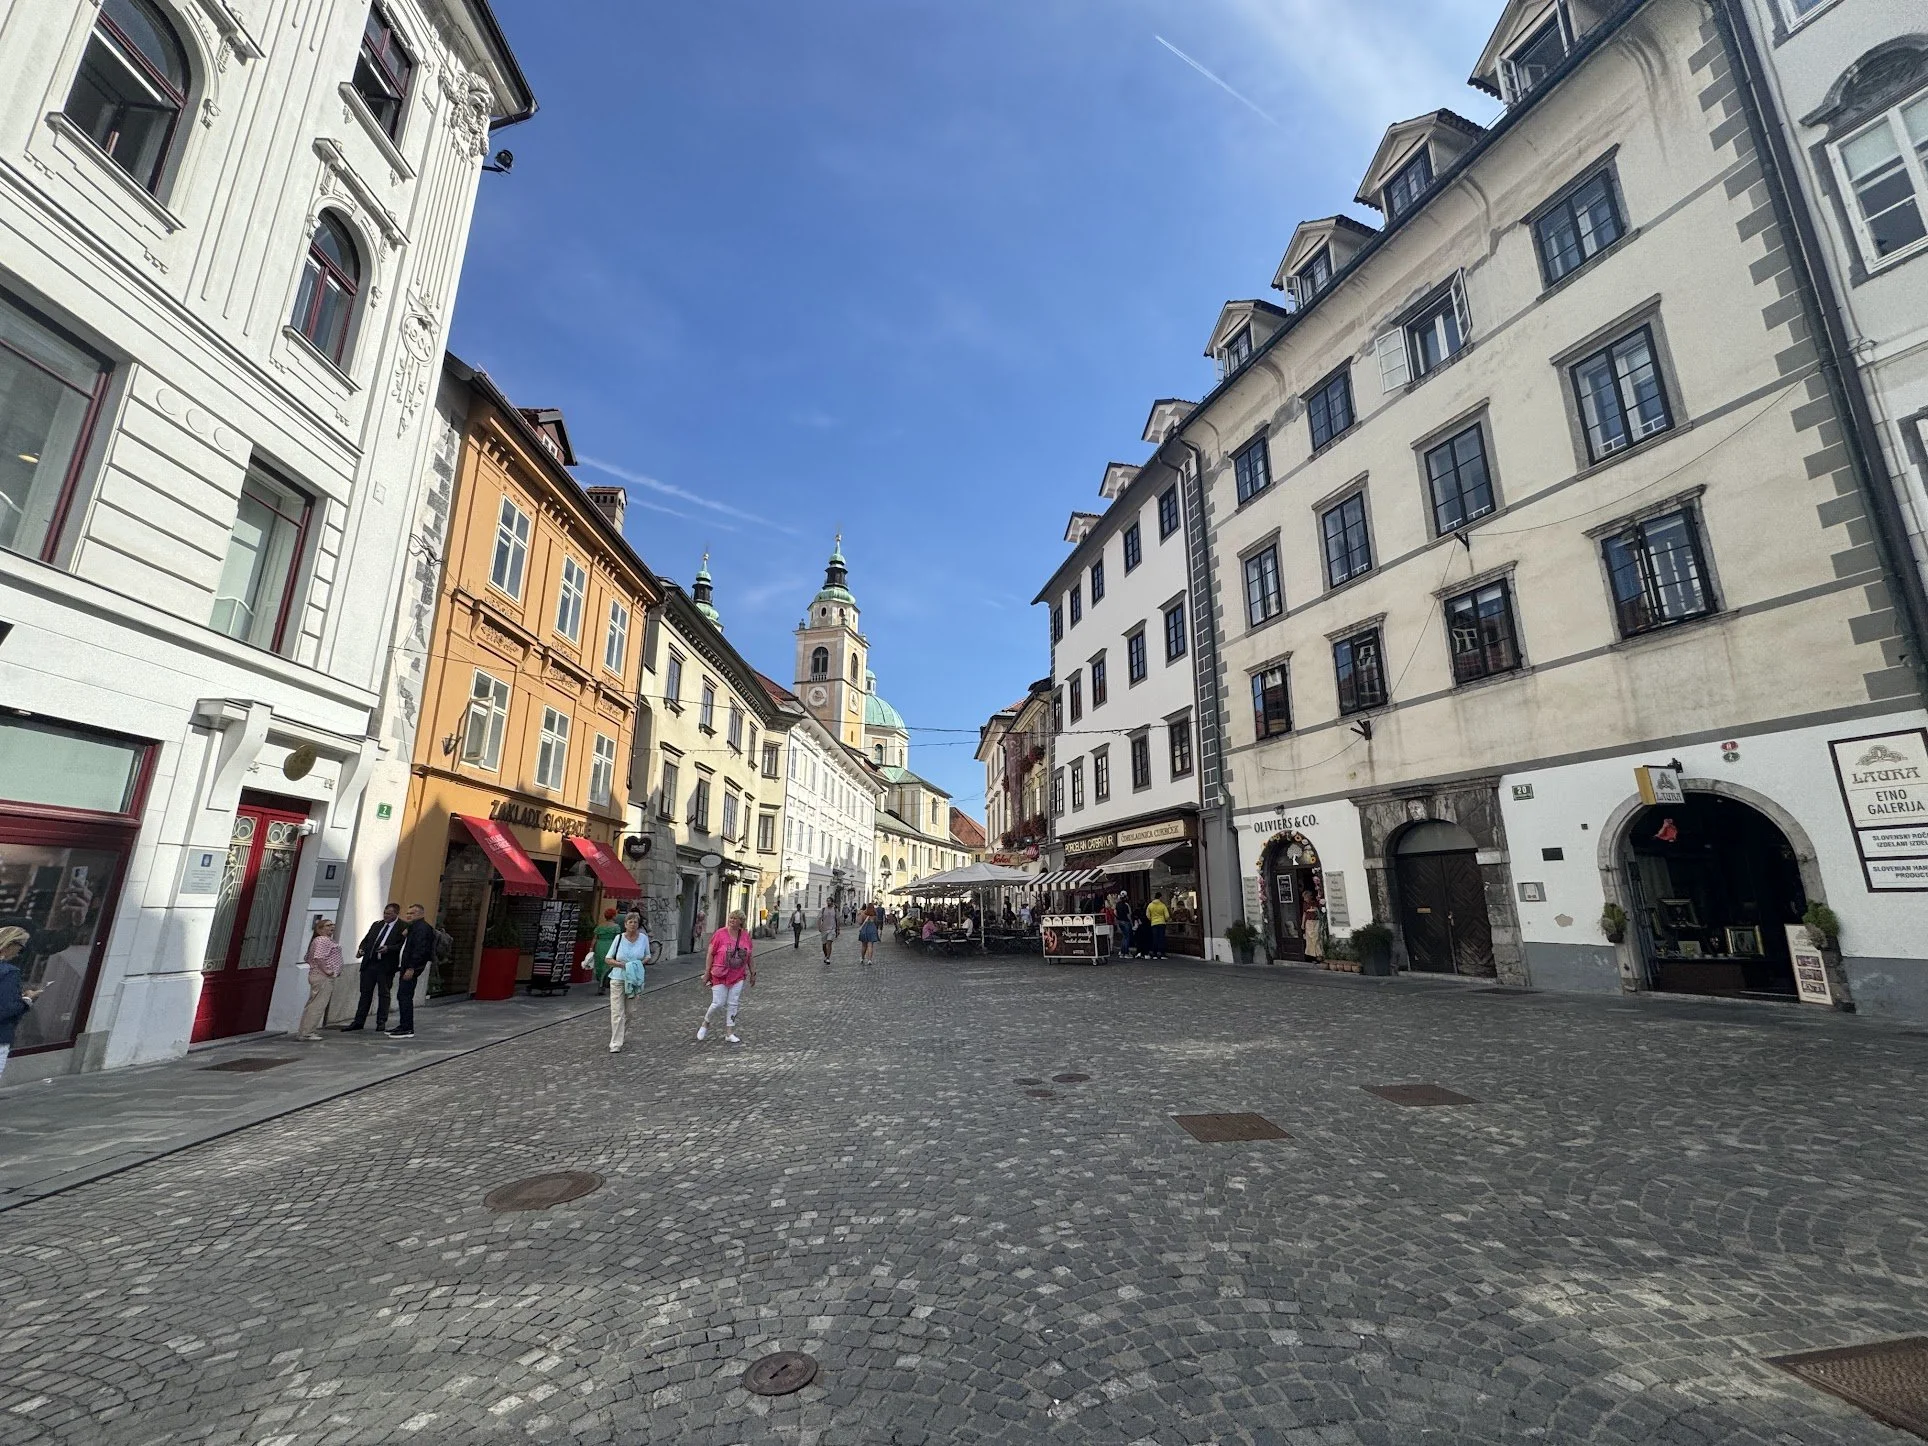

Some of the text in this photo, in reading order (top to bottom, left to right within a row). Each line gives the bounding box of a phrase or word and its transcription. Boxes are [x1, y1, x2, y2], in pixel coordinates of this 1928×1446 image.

[1851, 767, 1920, 784] LAURA
[1517, 786, 1527, 794] 20
[1876, 789, 1907, 801] ETNO
[1868, 800, 1926, 815] GALERIJA
[1254, 814, 1319, 833] OLIVIERS & CO.
[1912, 831, 1928, 840] ROČ
